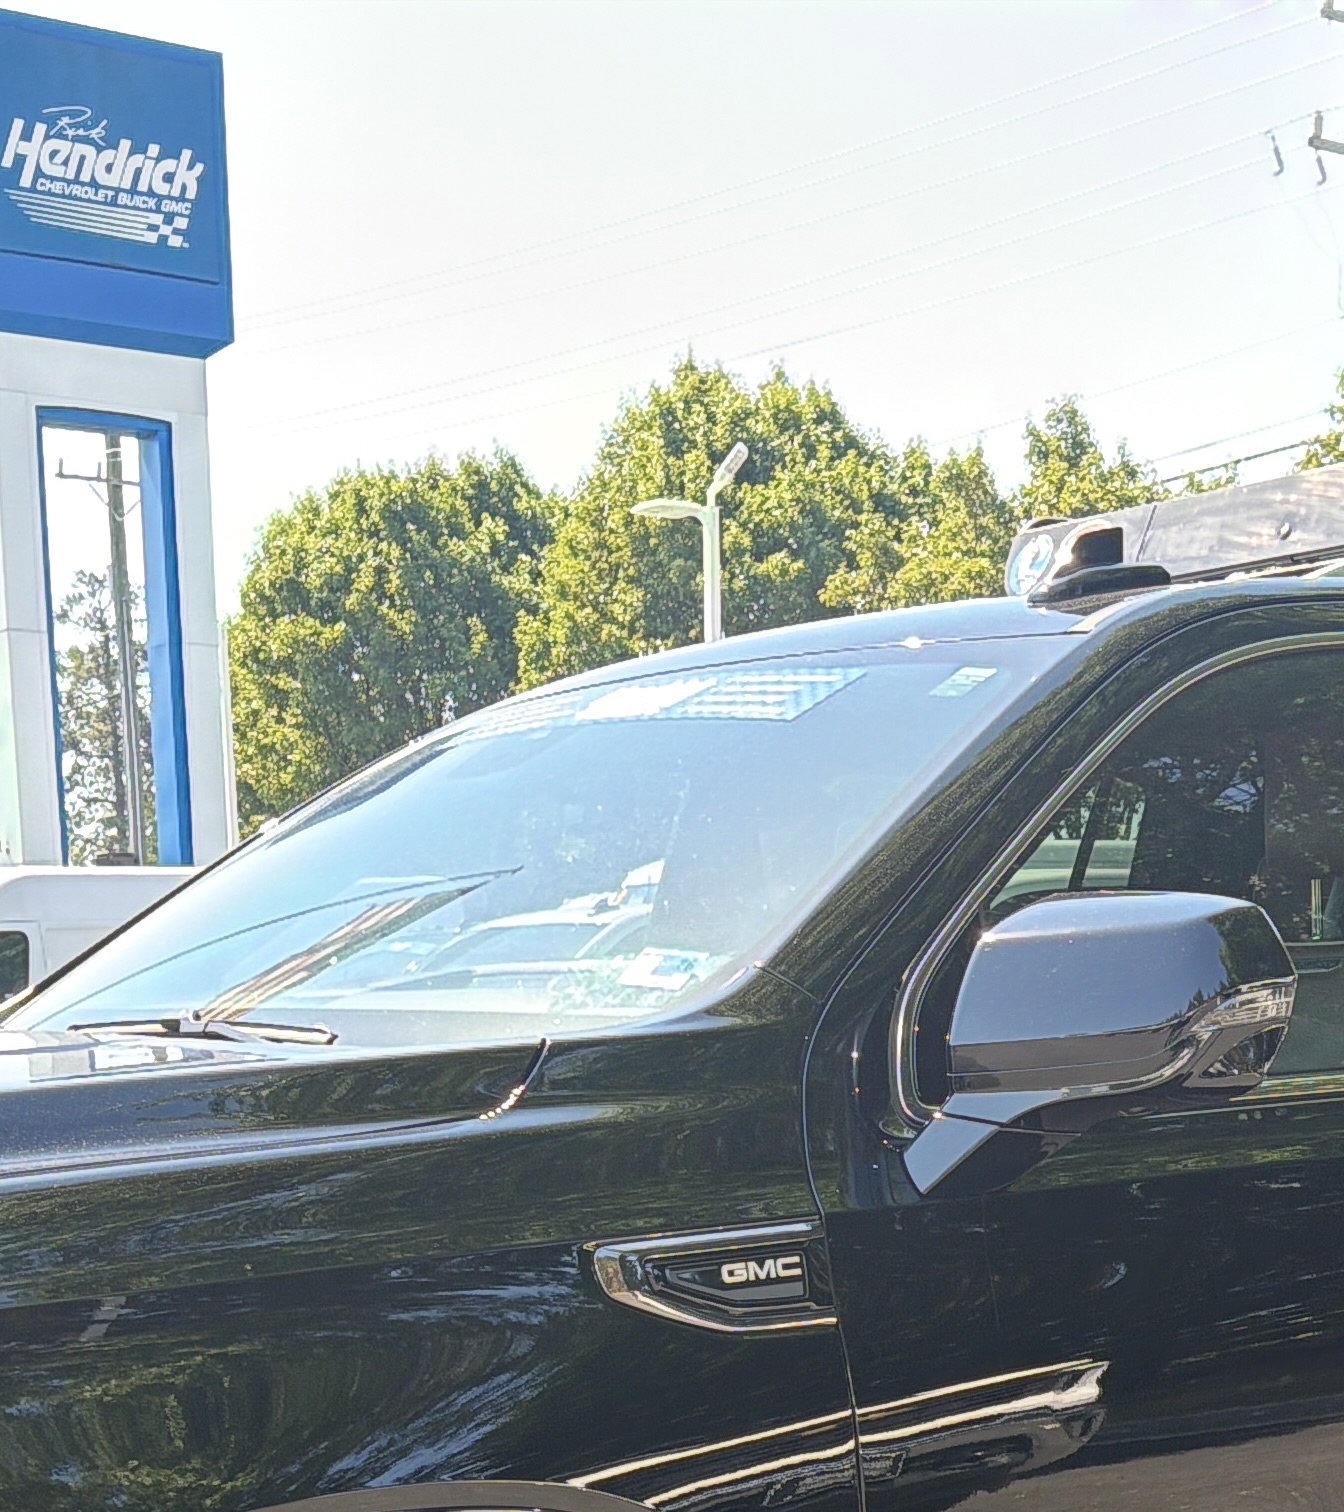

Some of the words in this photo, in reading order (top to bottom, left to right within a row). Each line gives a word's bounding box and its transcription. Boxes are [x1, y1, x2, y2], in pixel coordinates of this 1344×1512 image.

[1, 117, 205, 199] Hendrick
[36, 178, 116, 205] CHEVROLET
[117, 192, 159, 210] BUICK
[160, 199, 192, 216] GMC
[720, 1255, 803, 1285] GMC
